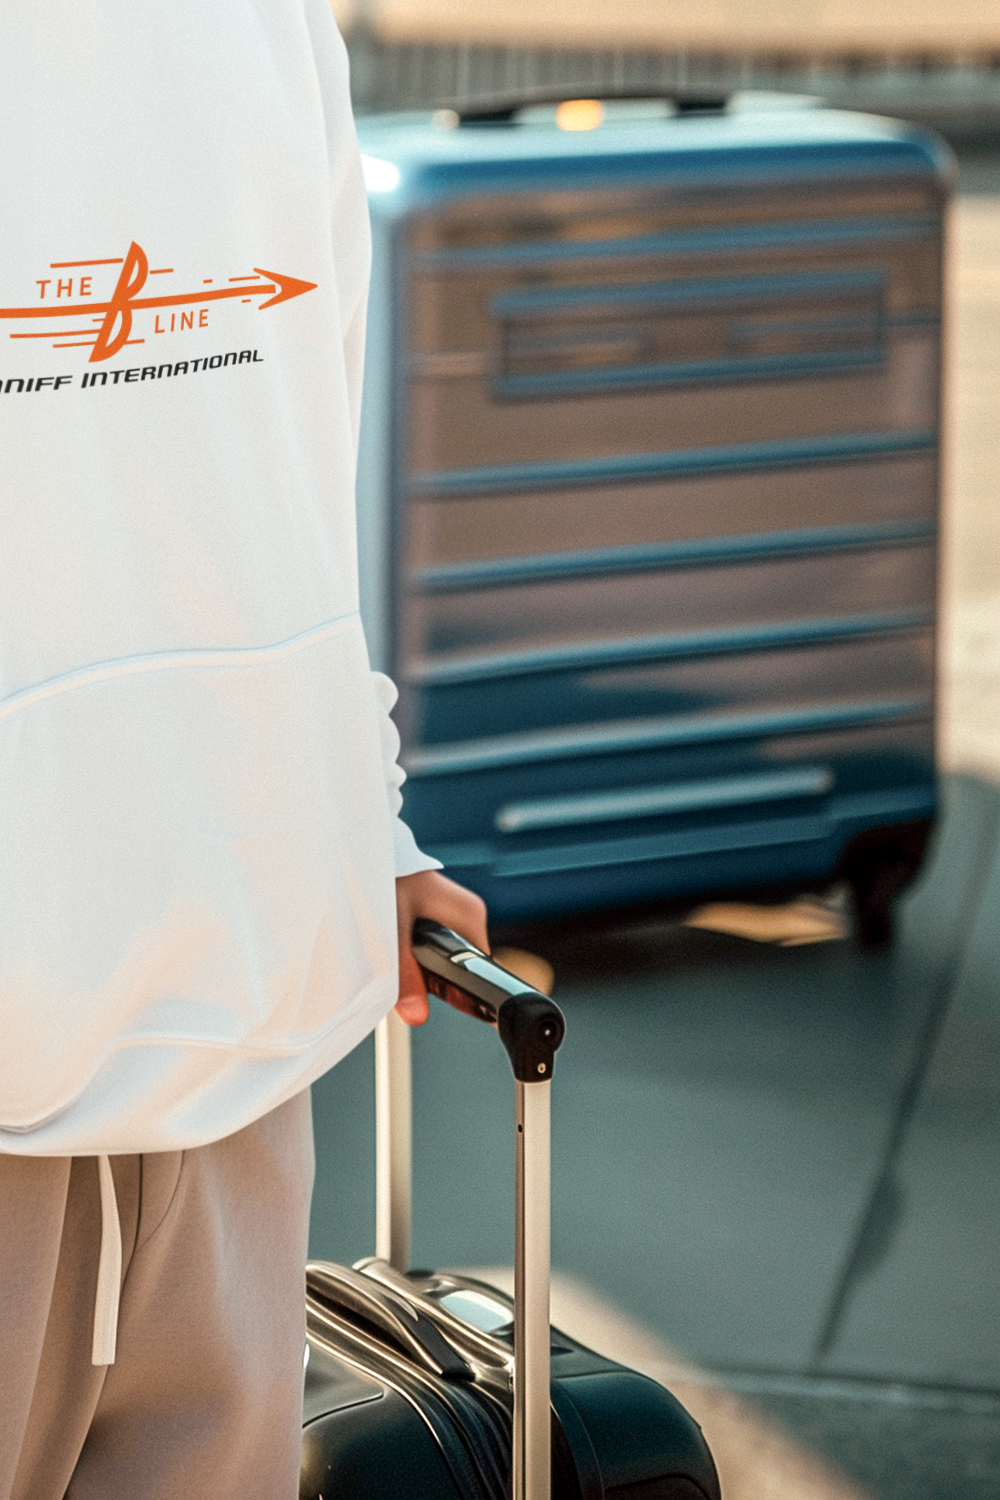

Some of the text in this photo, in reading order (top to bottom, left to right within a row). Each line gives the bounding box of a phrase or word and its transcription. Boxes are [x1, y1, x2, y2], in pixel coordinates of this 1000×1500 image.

[35, 276, 93, 300] THE
[154, 308, 210, 334] LINE
[80, 349, 265, 389] INTERNATIONAL
